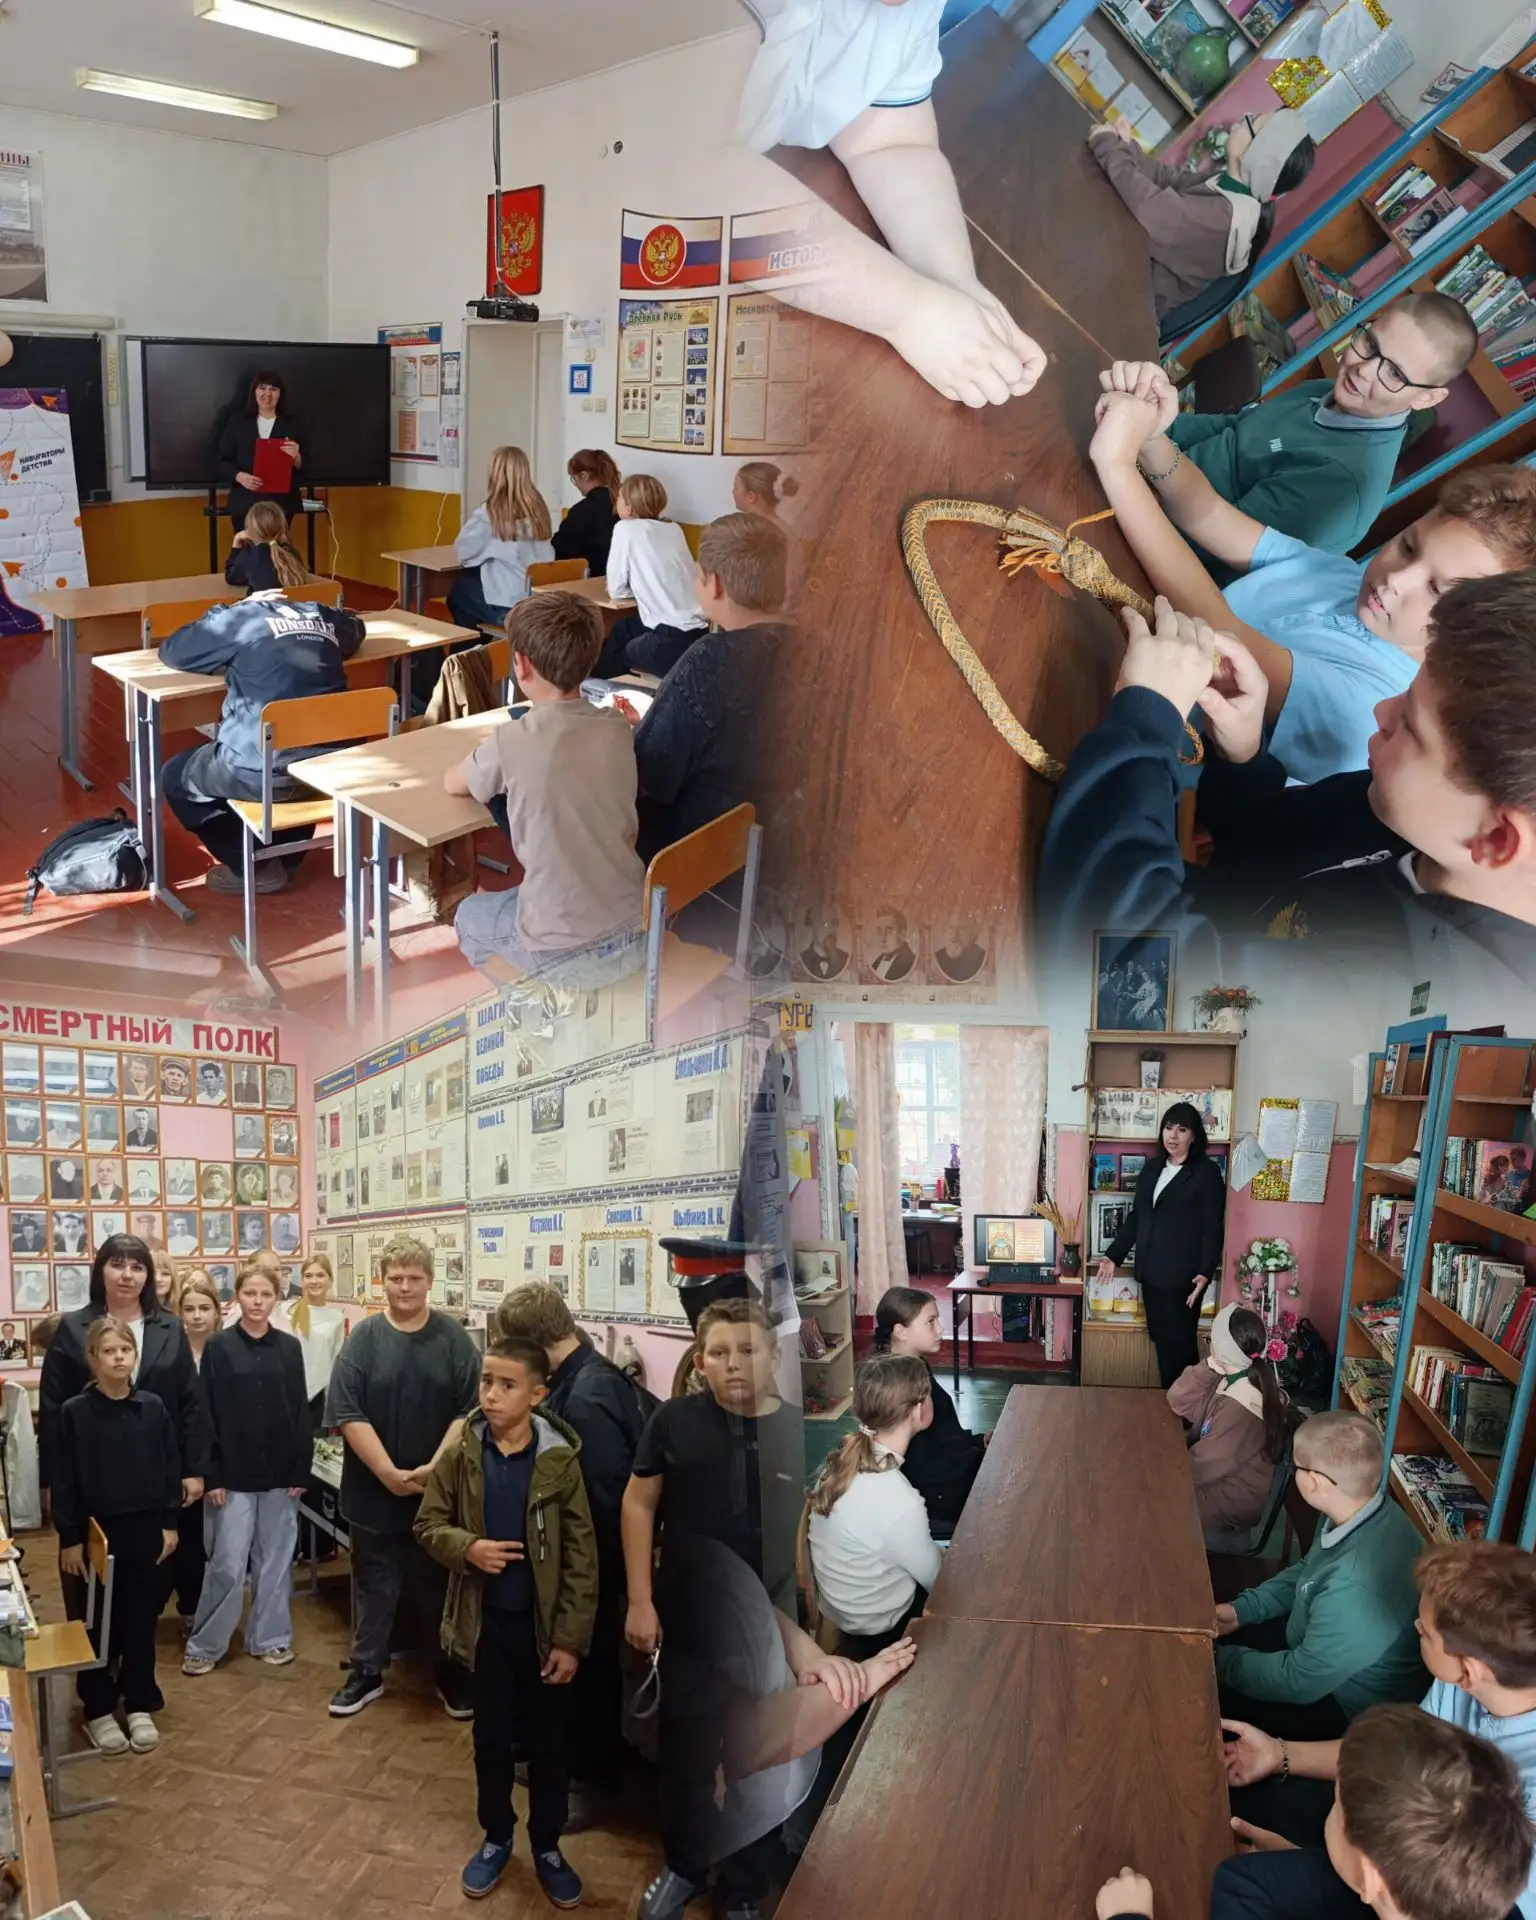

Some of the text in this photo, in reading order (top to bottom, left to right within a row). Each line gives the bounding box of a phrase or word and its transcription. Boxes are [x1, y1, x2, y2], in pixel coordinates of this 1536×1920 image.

[21, 459, 53, 473] ДЕТСТВА
[265, 616, 339, 647] LONSDALE
[296, 633, 324, 643] LONDON
[477, 1000, 506, 1027] ШАГИ
[192, 1023, 274, 1058] ПОЛК
[476, 1060, 505, 1085] ПОБЕДЫ
